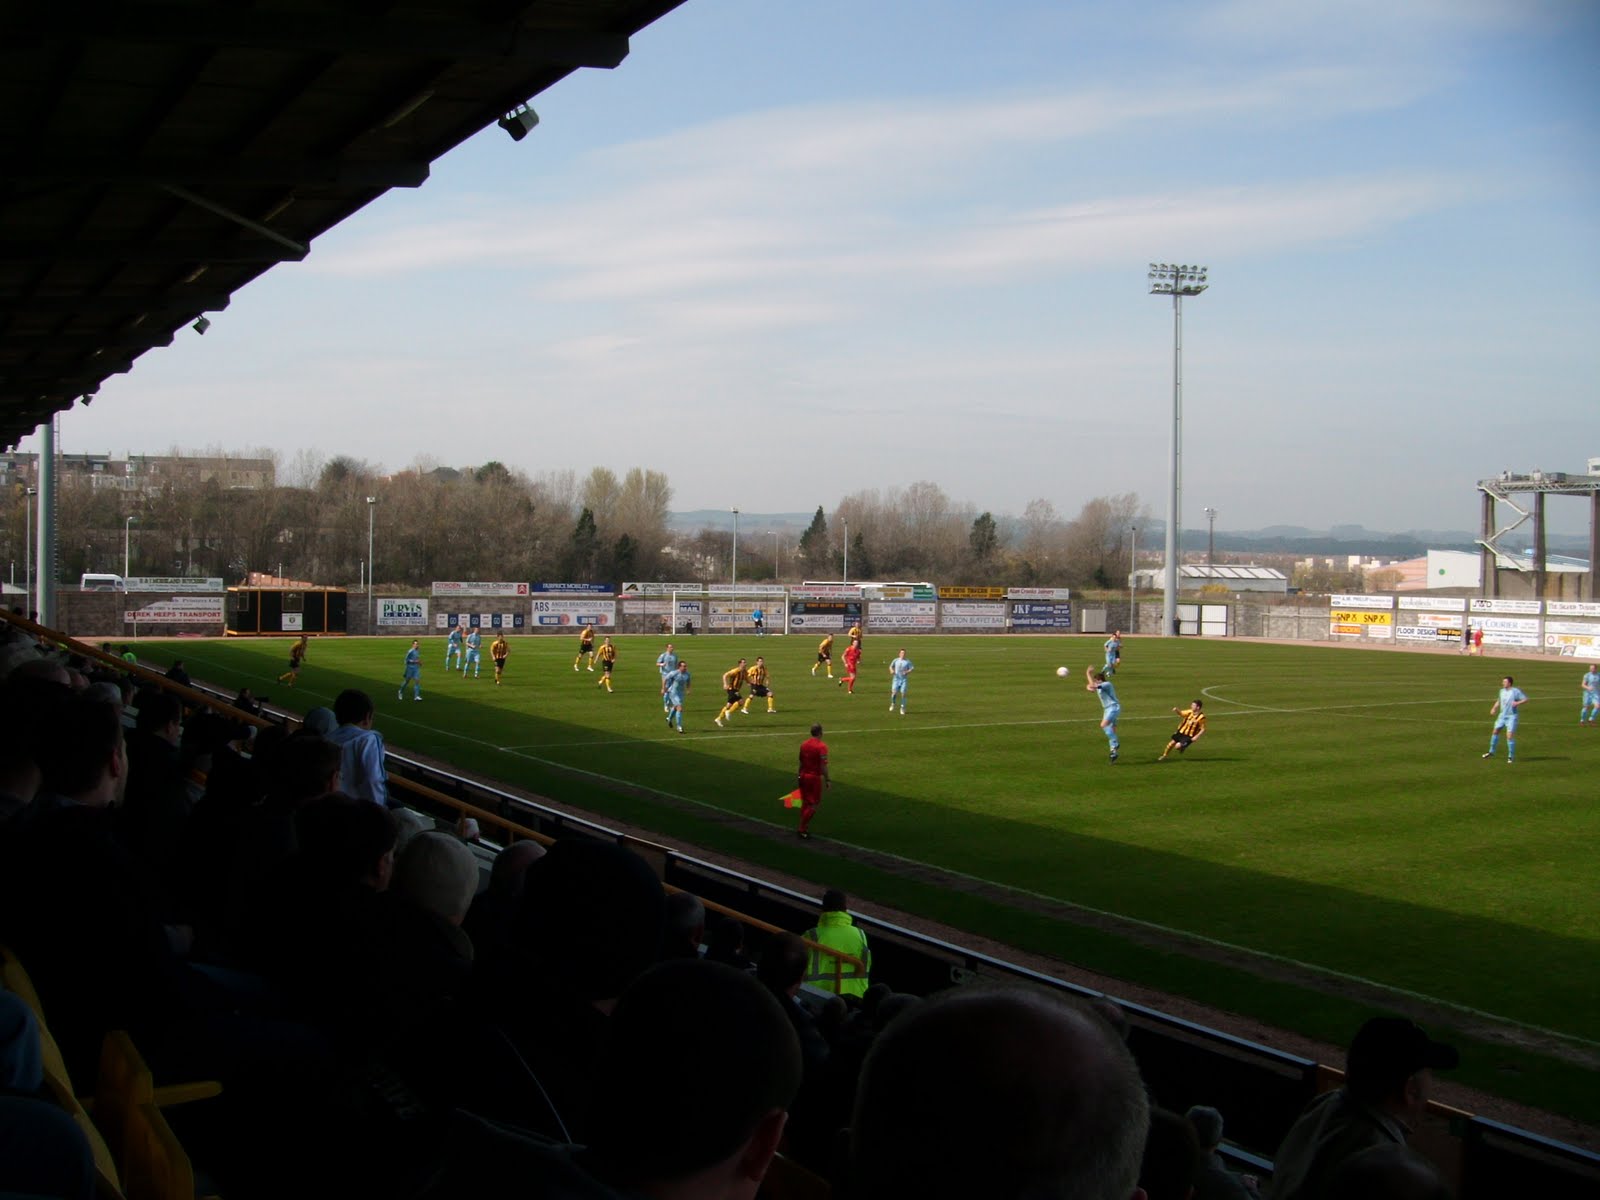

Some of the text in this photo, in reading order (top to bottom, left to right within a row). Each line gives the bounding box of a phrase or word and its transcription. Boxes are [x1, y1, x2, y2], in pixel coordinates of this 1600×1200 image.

[534, 602, 549, 611] ABS
[1013, 605, 1030, 614] JKF
[1485, 619, 1518, 628] COURIER
